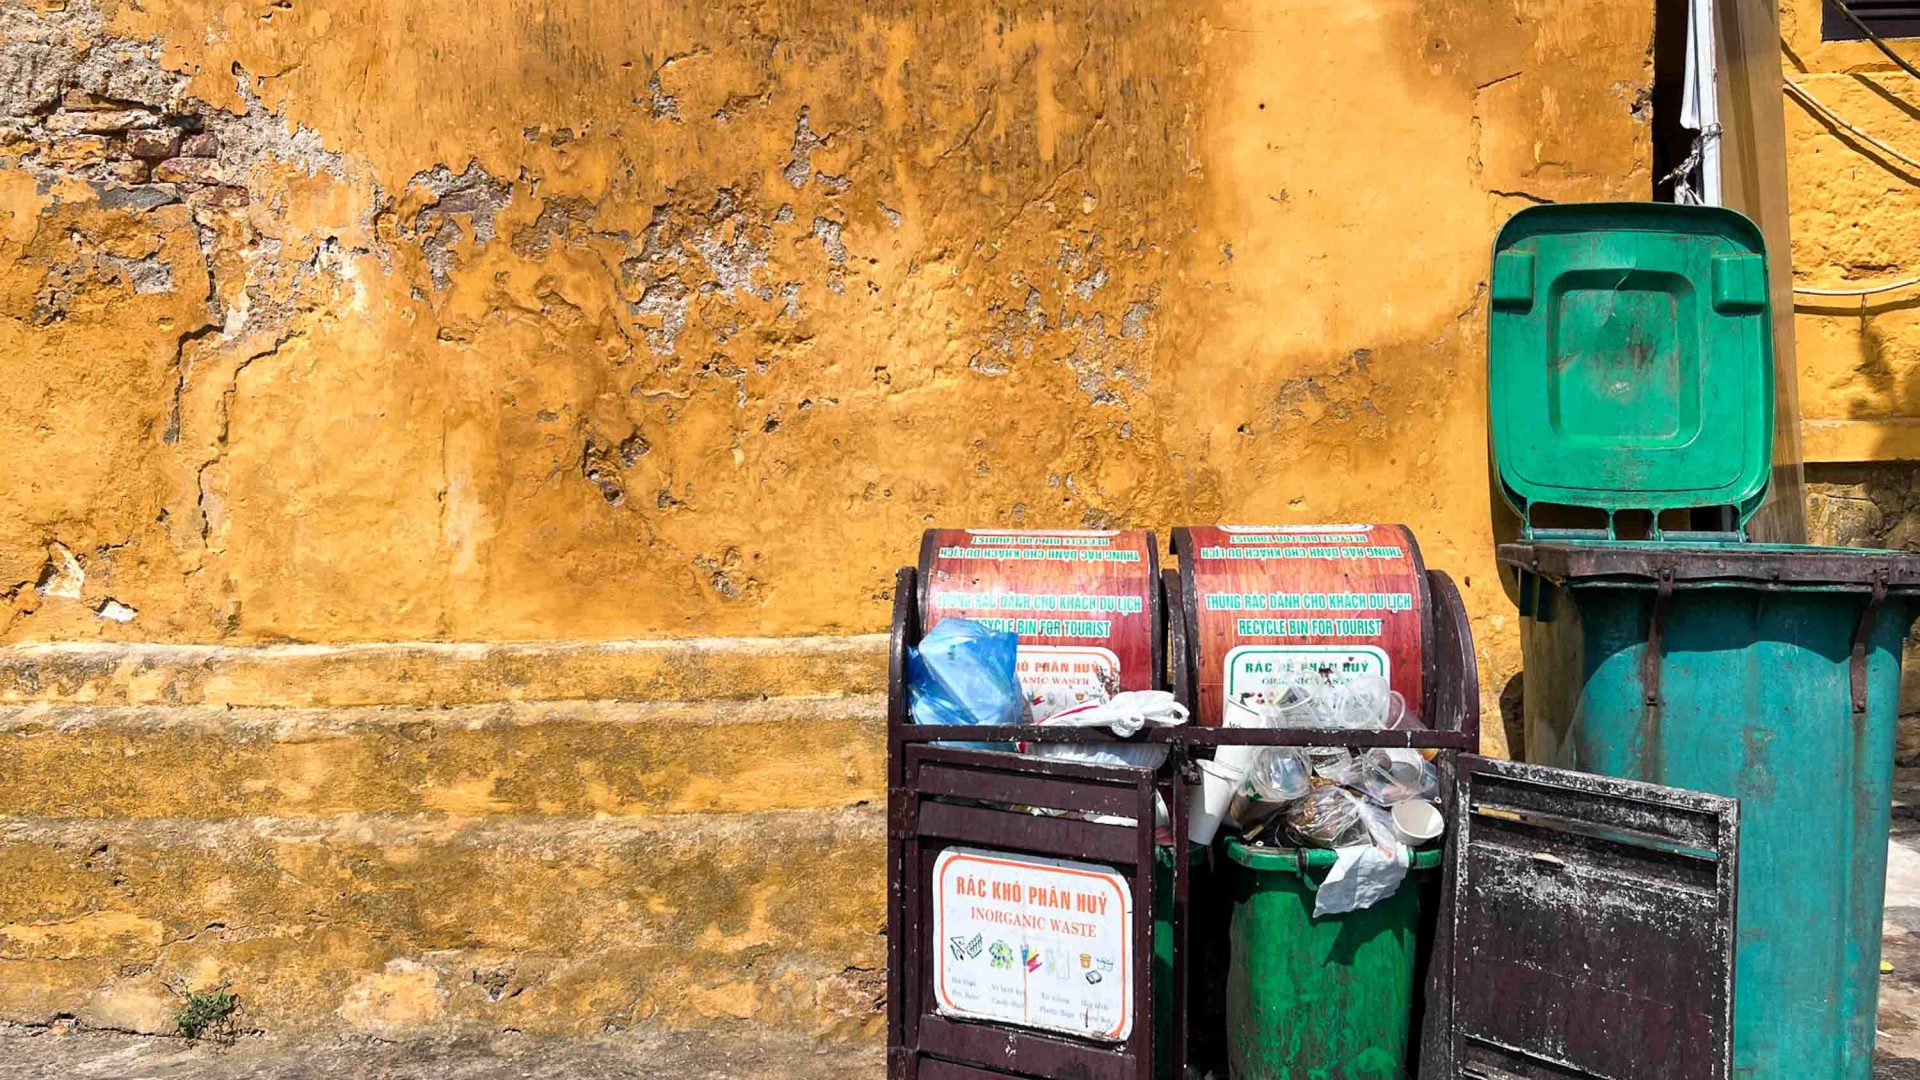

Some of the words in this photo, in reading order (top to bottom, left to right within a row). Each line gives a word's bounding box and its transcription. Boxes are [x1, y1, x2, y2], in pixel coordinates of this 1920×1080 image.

[966, 549, 981, 559] DU
[1023, 550, 1044, 559] CHO
[1228, 548, 1242, 558] DU
[1284, 548, 1306, 558] CHO
[1034, 595, 1055, 609] CHO
[1100, 596, 1115, 611] DU
[1118, 596, 1141, 615] LỊCH
[1206, 592, 1241, 609] THÙNG
[1244, 592, 1266, 609] RÁC
[1269, 592, 1301, 609] DÀNH
[1304, 594, 1325, 609] CHO
[1329, 592, 1366, 609] KHÁCH
[1369, 594, 1384, 609] DU
[1387, 594, 1411, 613] LỊCH
[1017, 620, 1037, 635] BIN
[1040, 620, 1061, 636] FOR
[1064, 620, 1110, 637] TOURIST
[1239, 619, 1286, 636] RECYCLE
[1289, 619, 1308, 635] BIN
[1312, 619, 1333, 635] FOR
[1336, 619, 1382, 635] TOURIST
[956, 874, 986, 898] RÁC
[1028, 885, 1071, 911] PHÂN
[970, 907, 1046, 930] INORGANIC
[1050, 919, 1097, 938] WASTE
